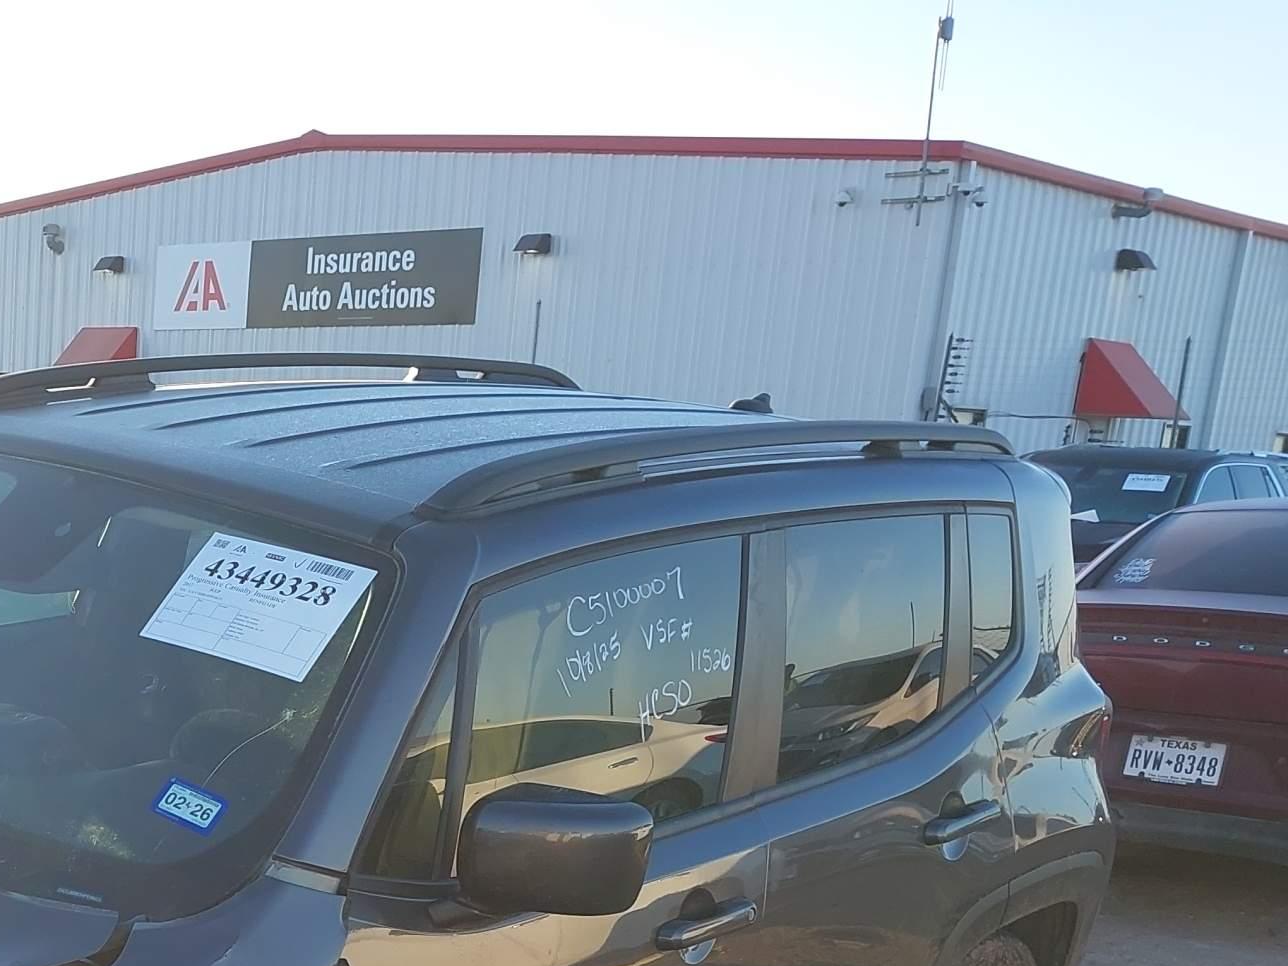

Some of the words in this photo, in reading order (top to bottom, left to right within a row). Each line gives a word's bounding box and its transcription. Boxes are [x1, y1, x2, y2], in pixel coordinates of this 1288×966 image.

[305, 246, 416, 275] Insurance
[281, 284, 331, 312] Auto
[336, 279, 436, 310] Auctions
[203, 557, 337, 607] 43449328
[689, 647, 732, 674] 11526
[1159, 738, 1198, 751] TEXAS
